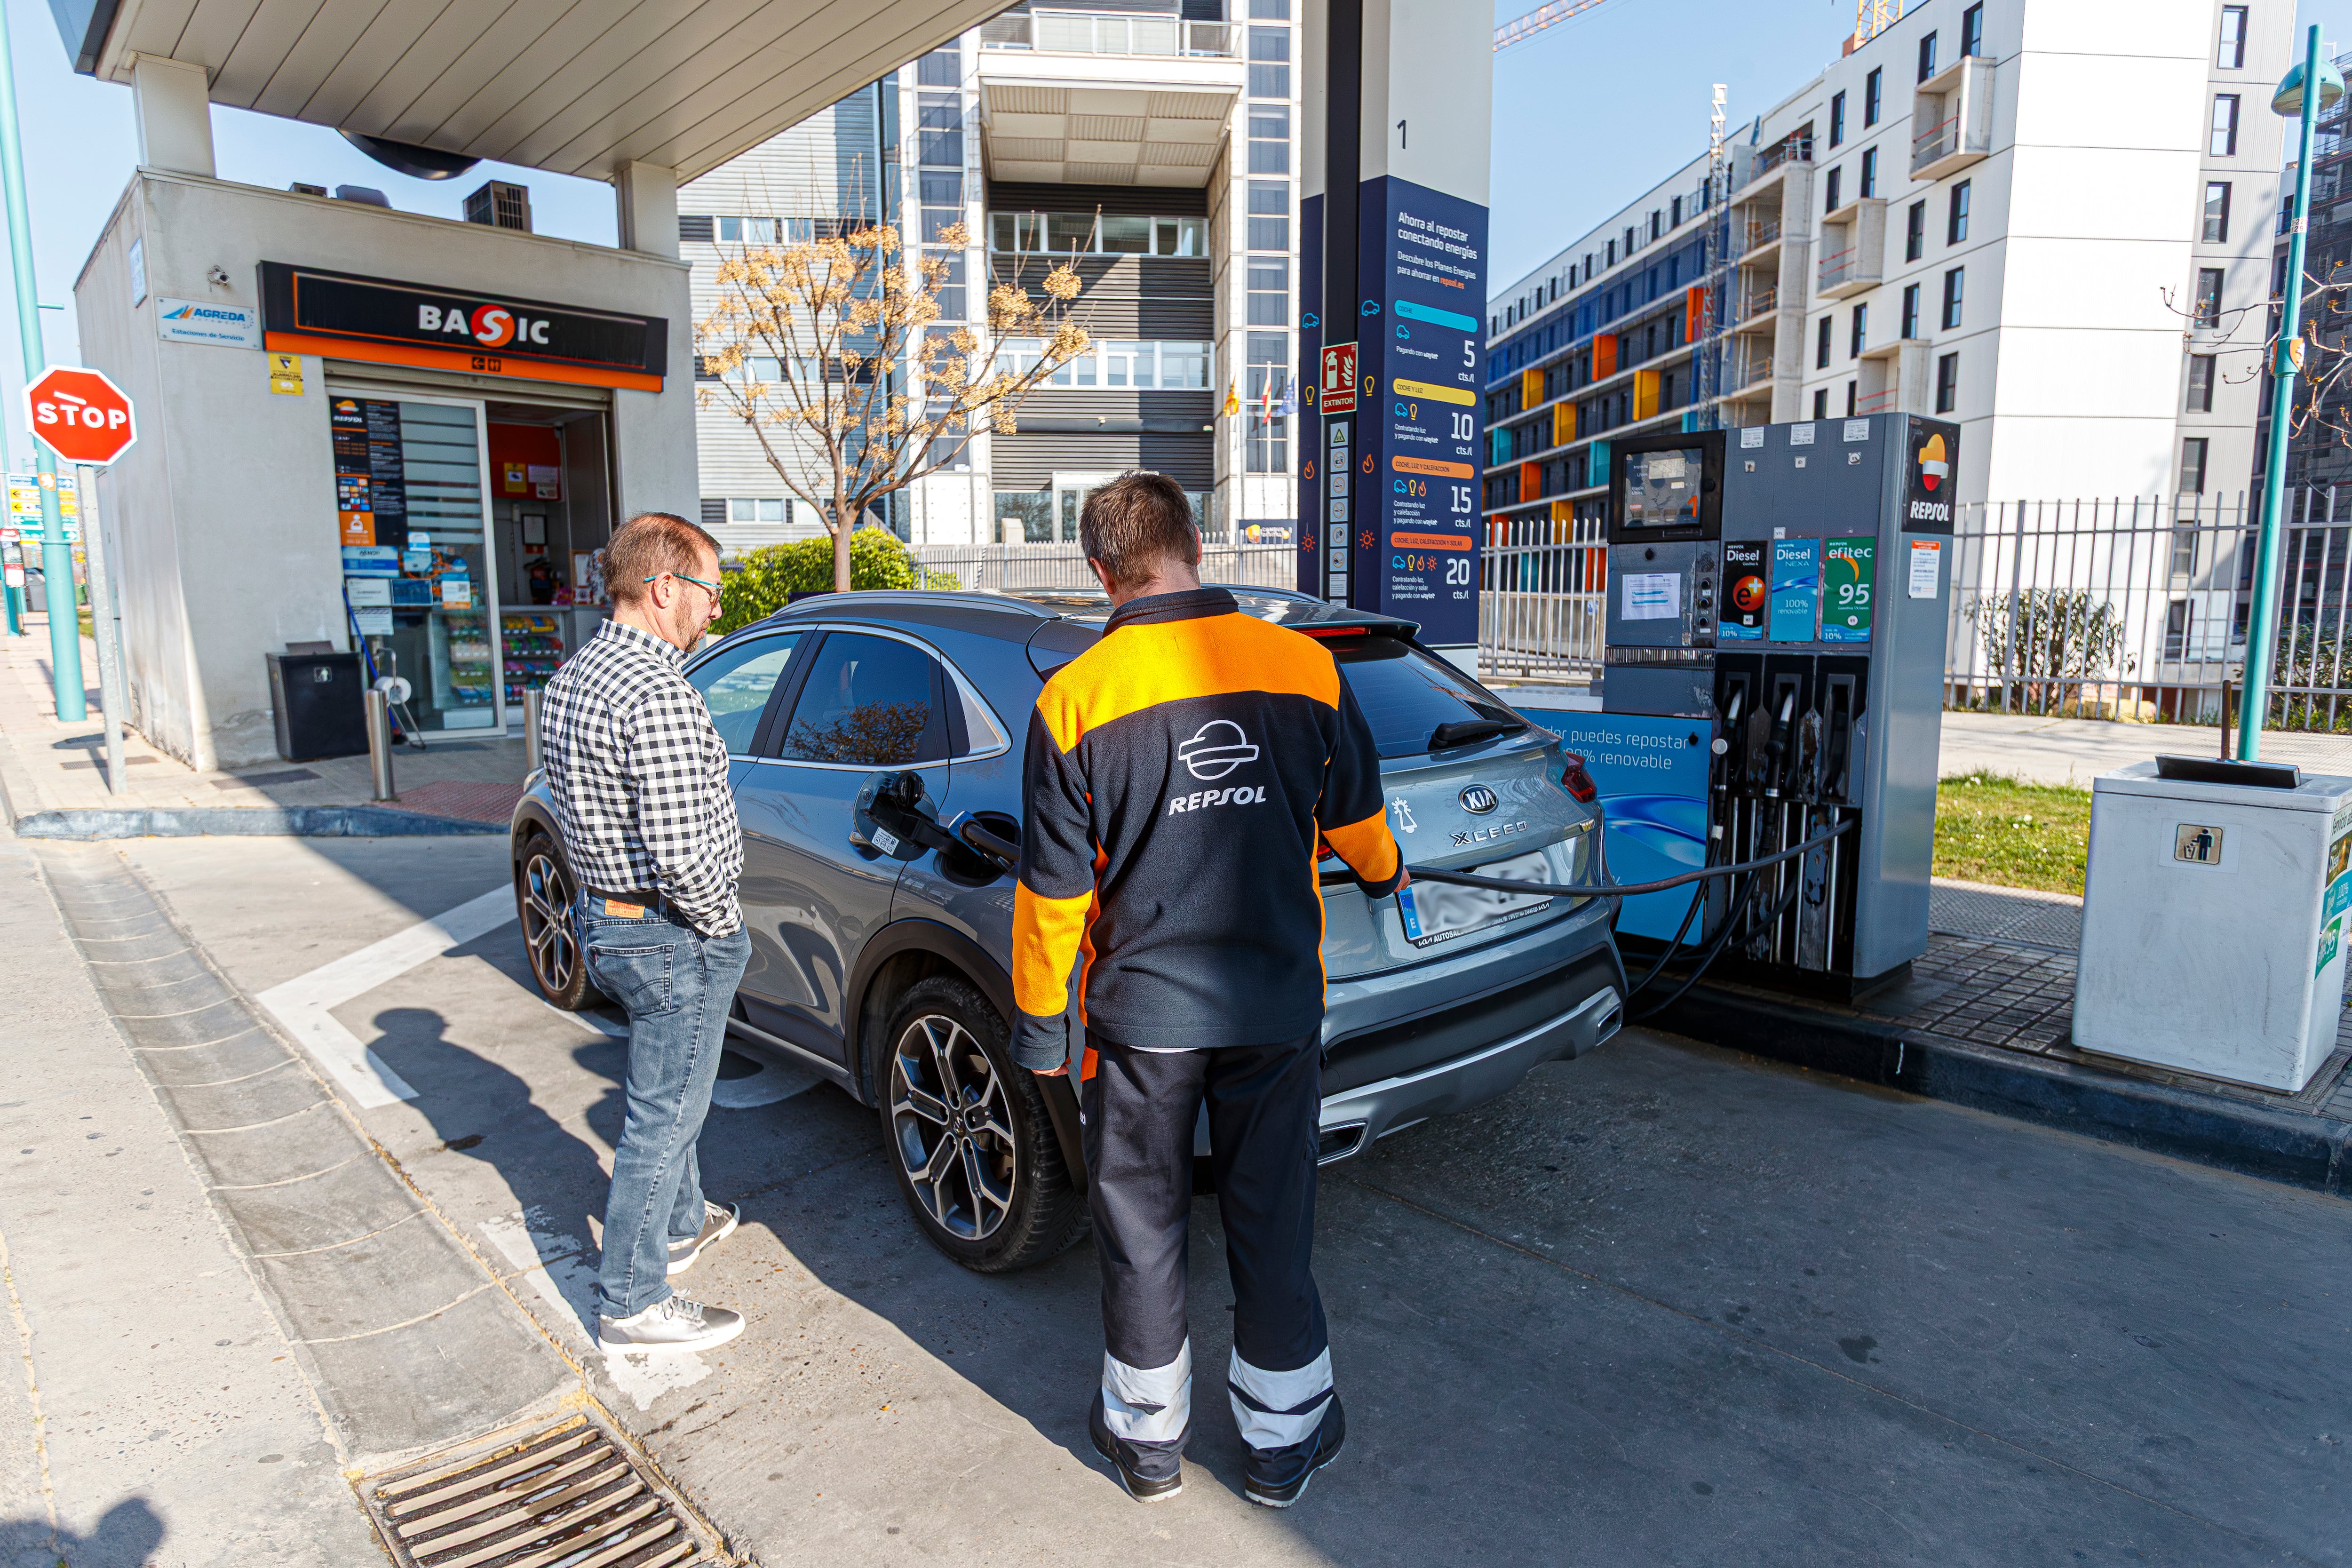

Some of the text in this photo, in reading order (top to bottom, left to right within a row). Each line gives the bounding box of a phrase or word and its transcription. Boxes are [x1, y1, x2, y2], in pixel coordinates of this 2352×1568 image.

[1397, 119, 1407, 149] 1
[1398, 212, 1468, 242] Ahorra al repostar
[1398, 229, 1478, 259] conectando energías
[1397, 250, 1476, 279] Descubre los Planes Energías
[1397, 266, 1410, 275] para
[1411, 269, 1431, 280] ahorrar
[1440, 277, 1464, 289] repsol.es
[194, 308, 246, 321] AGREDA
[1398, 305, 1413, 314] COCHE
[172, 328, 207, 337] Estaciones
[419, 304, 550, 344] BASIC
[1396, 346, 1414, 355] Pagando
[1463, 340, 1475, 367] 5
[1324, 398, 1354, 407] EXTINTOR
[37, 402, 127, 430] STOP
[1451, 412, 1473, 441] 10
[1395, 423, 1420, 433] Contratando
[1451, 486, 1471, 513] 15
[1687, 495, 1698, 517] 1
[1910, 501, 1949, 522] REPSOL
[1727, 549, 1759, 561] Diesel
[1777, 549, 1811, 560] Diesel
[1828, 547, 1872, 559] efitec
[1446, 558, 1470, 585] 20
[1395, 592, 1413, 600] pagando
[1786, 599, 1808, 608] 100%
[1838, 584, 1869, 605] 95
[1571, 729, 1621, 744] puedes
[1626, 734, 1689, 750] repostar
[1600, 753, 1672, 770] renovable
[1168, 786, 1266, 816] REPSOL
[1465, 790, 1495, 809] KIA
[1450, 820, 1528, 847] XCEED
[2332, 812, 2347, 836] Servicio
[1410, 918, 1416, 929] E
[1418, 937, 1433, 947] KIA
